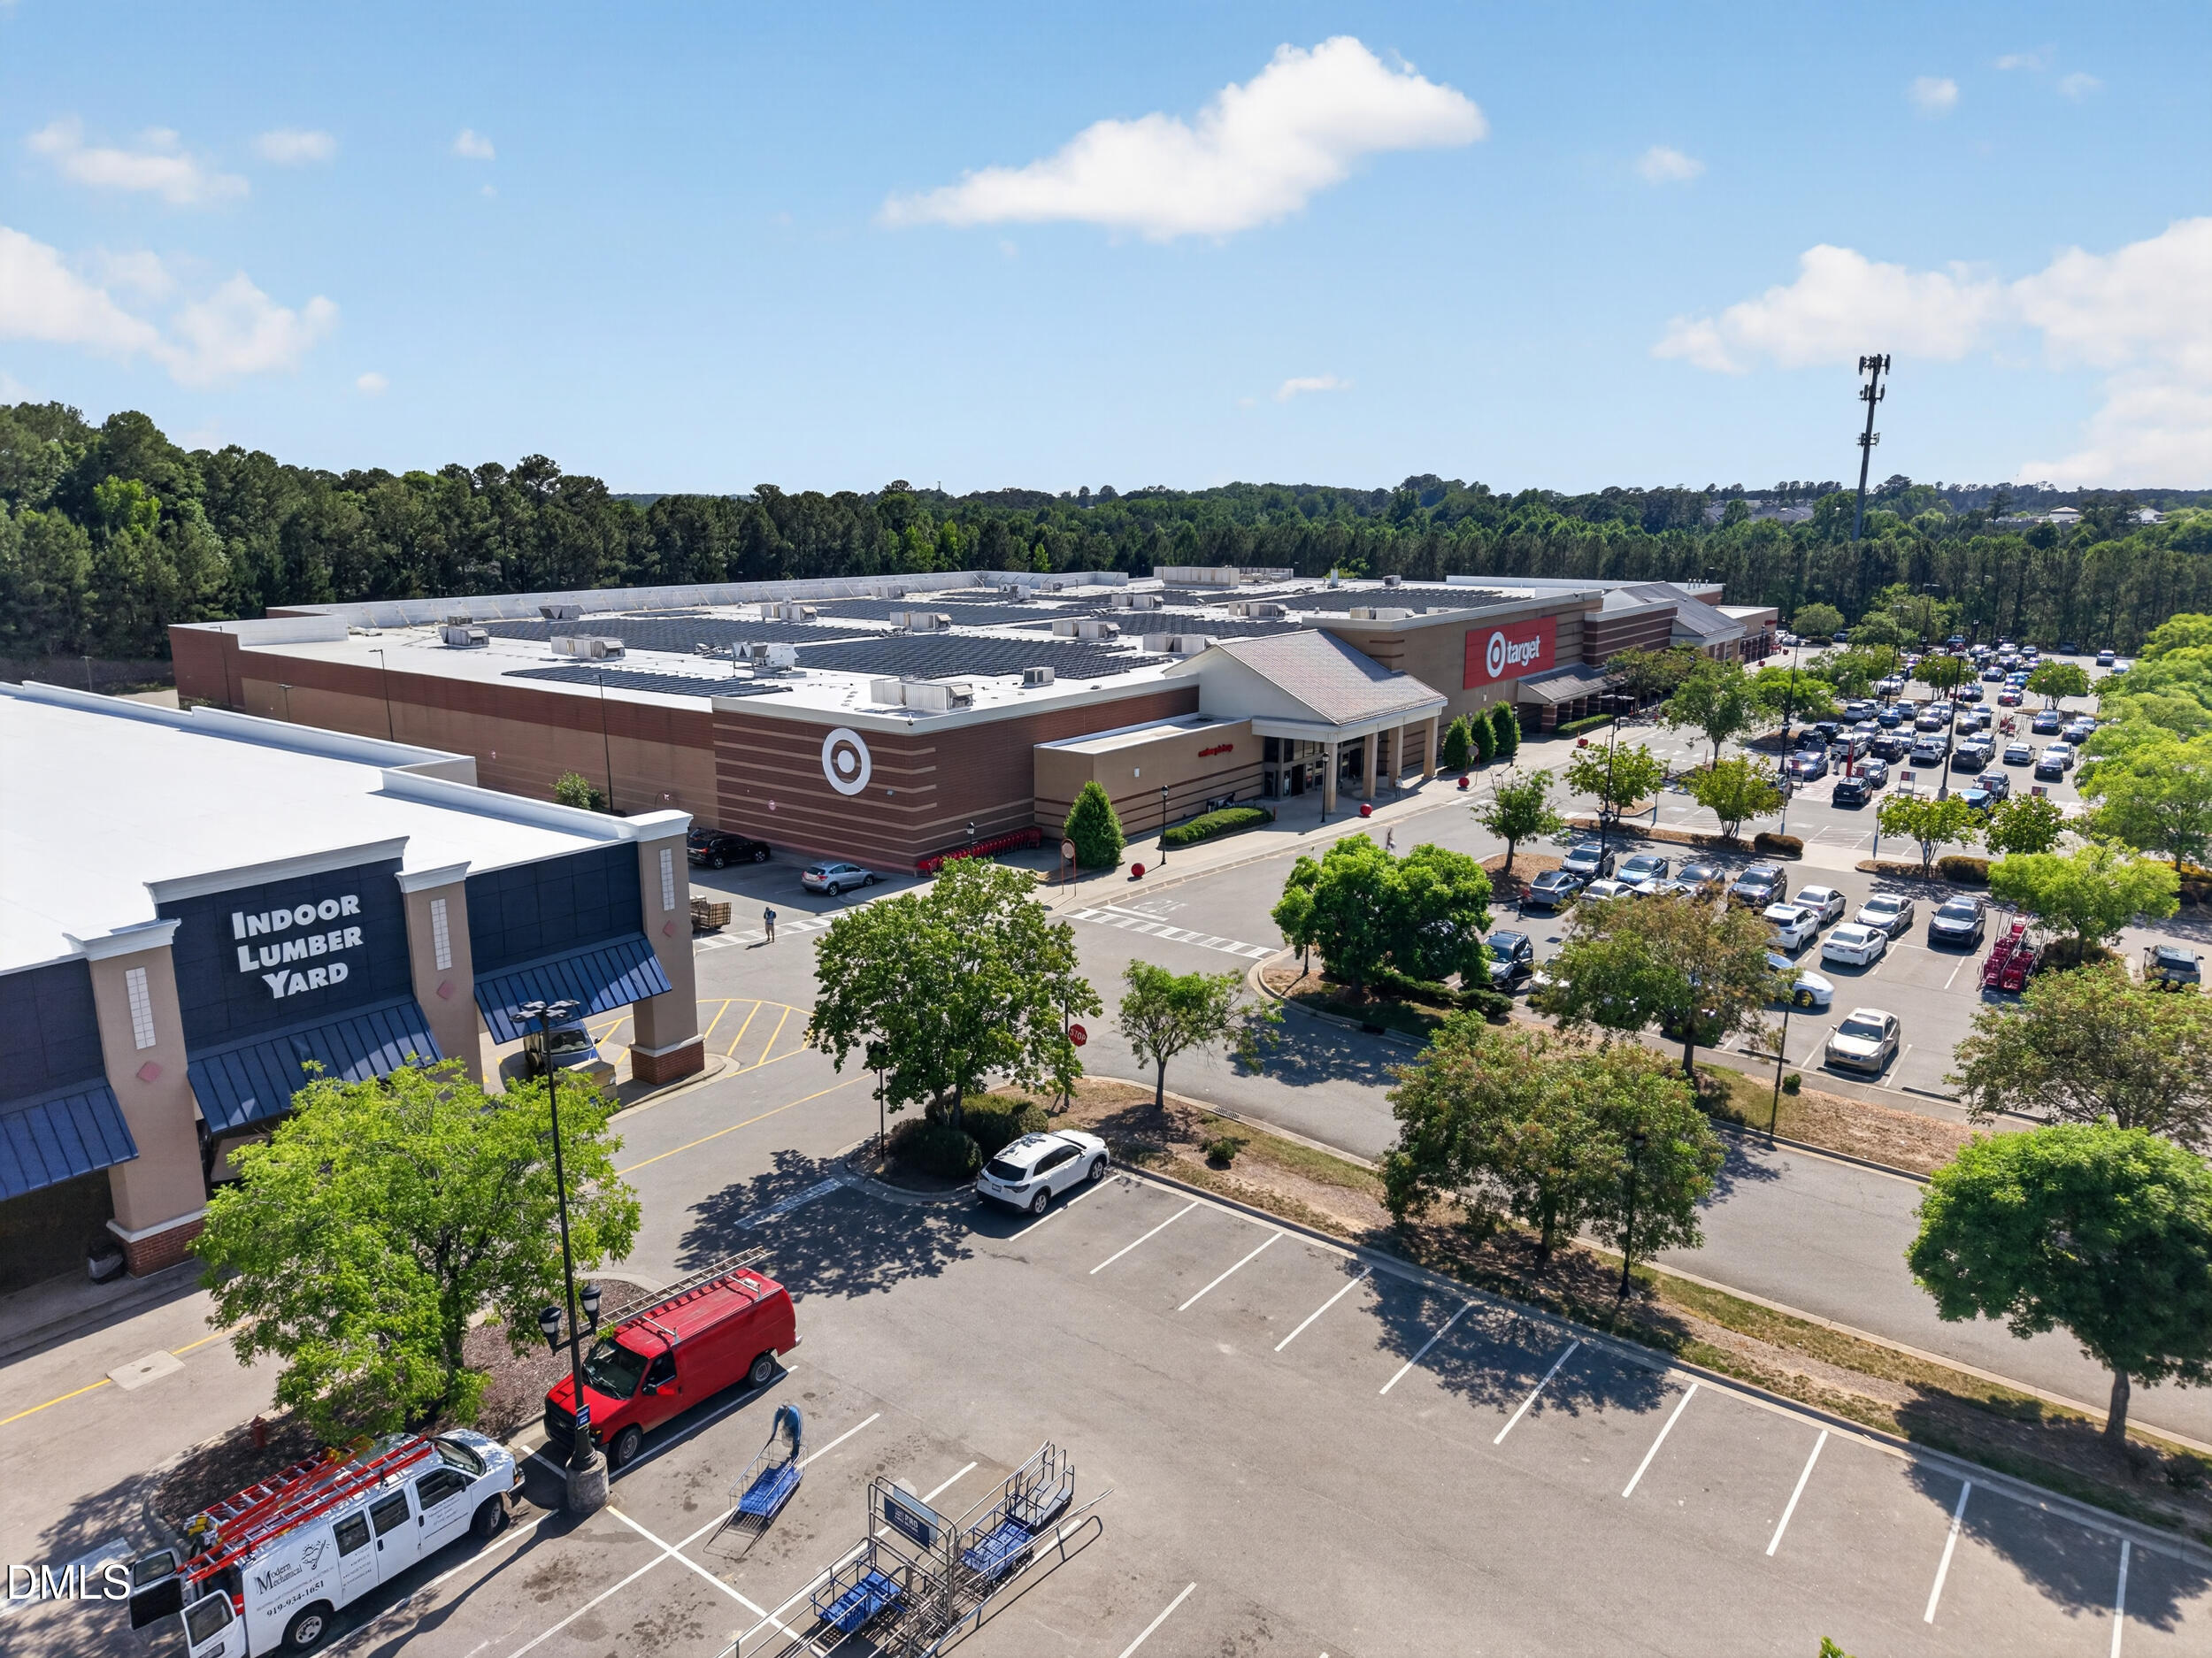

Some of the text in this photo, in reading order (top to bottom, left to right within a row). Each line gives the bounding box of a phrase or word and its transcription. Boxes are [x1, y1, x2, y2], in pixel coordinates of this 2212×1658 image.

[1507, 635, 1540, 666] target
[232, 894, 361, 940] INDOOR
[237, 926, 364, 972] LUMBER
[262, 963, 349, 999] YARD
[1070, 1028, 1086, 1040] STOP
[254, 1562, 291, 1595] Modern
